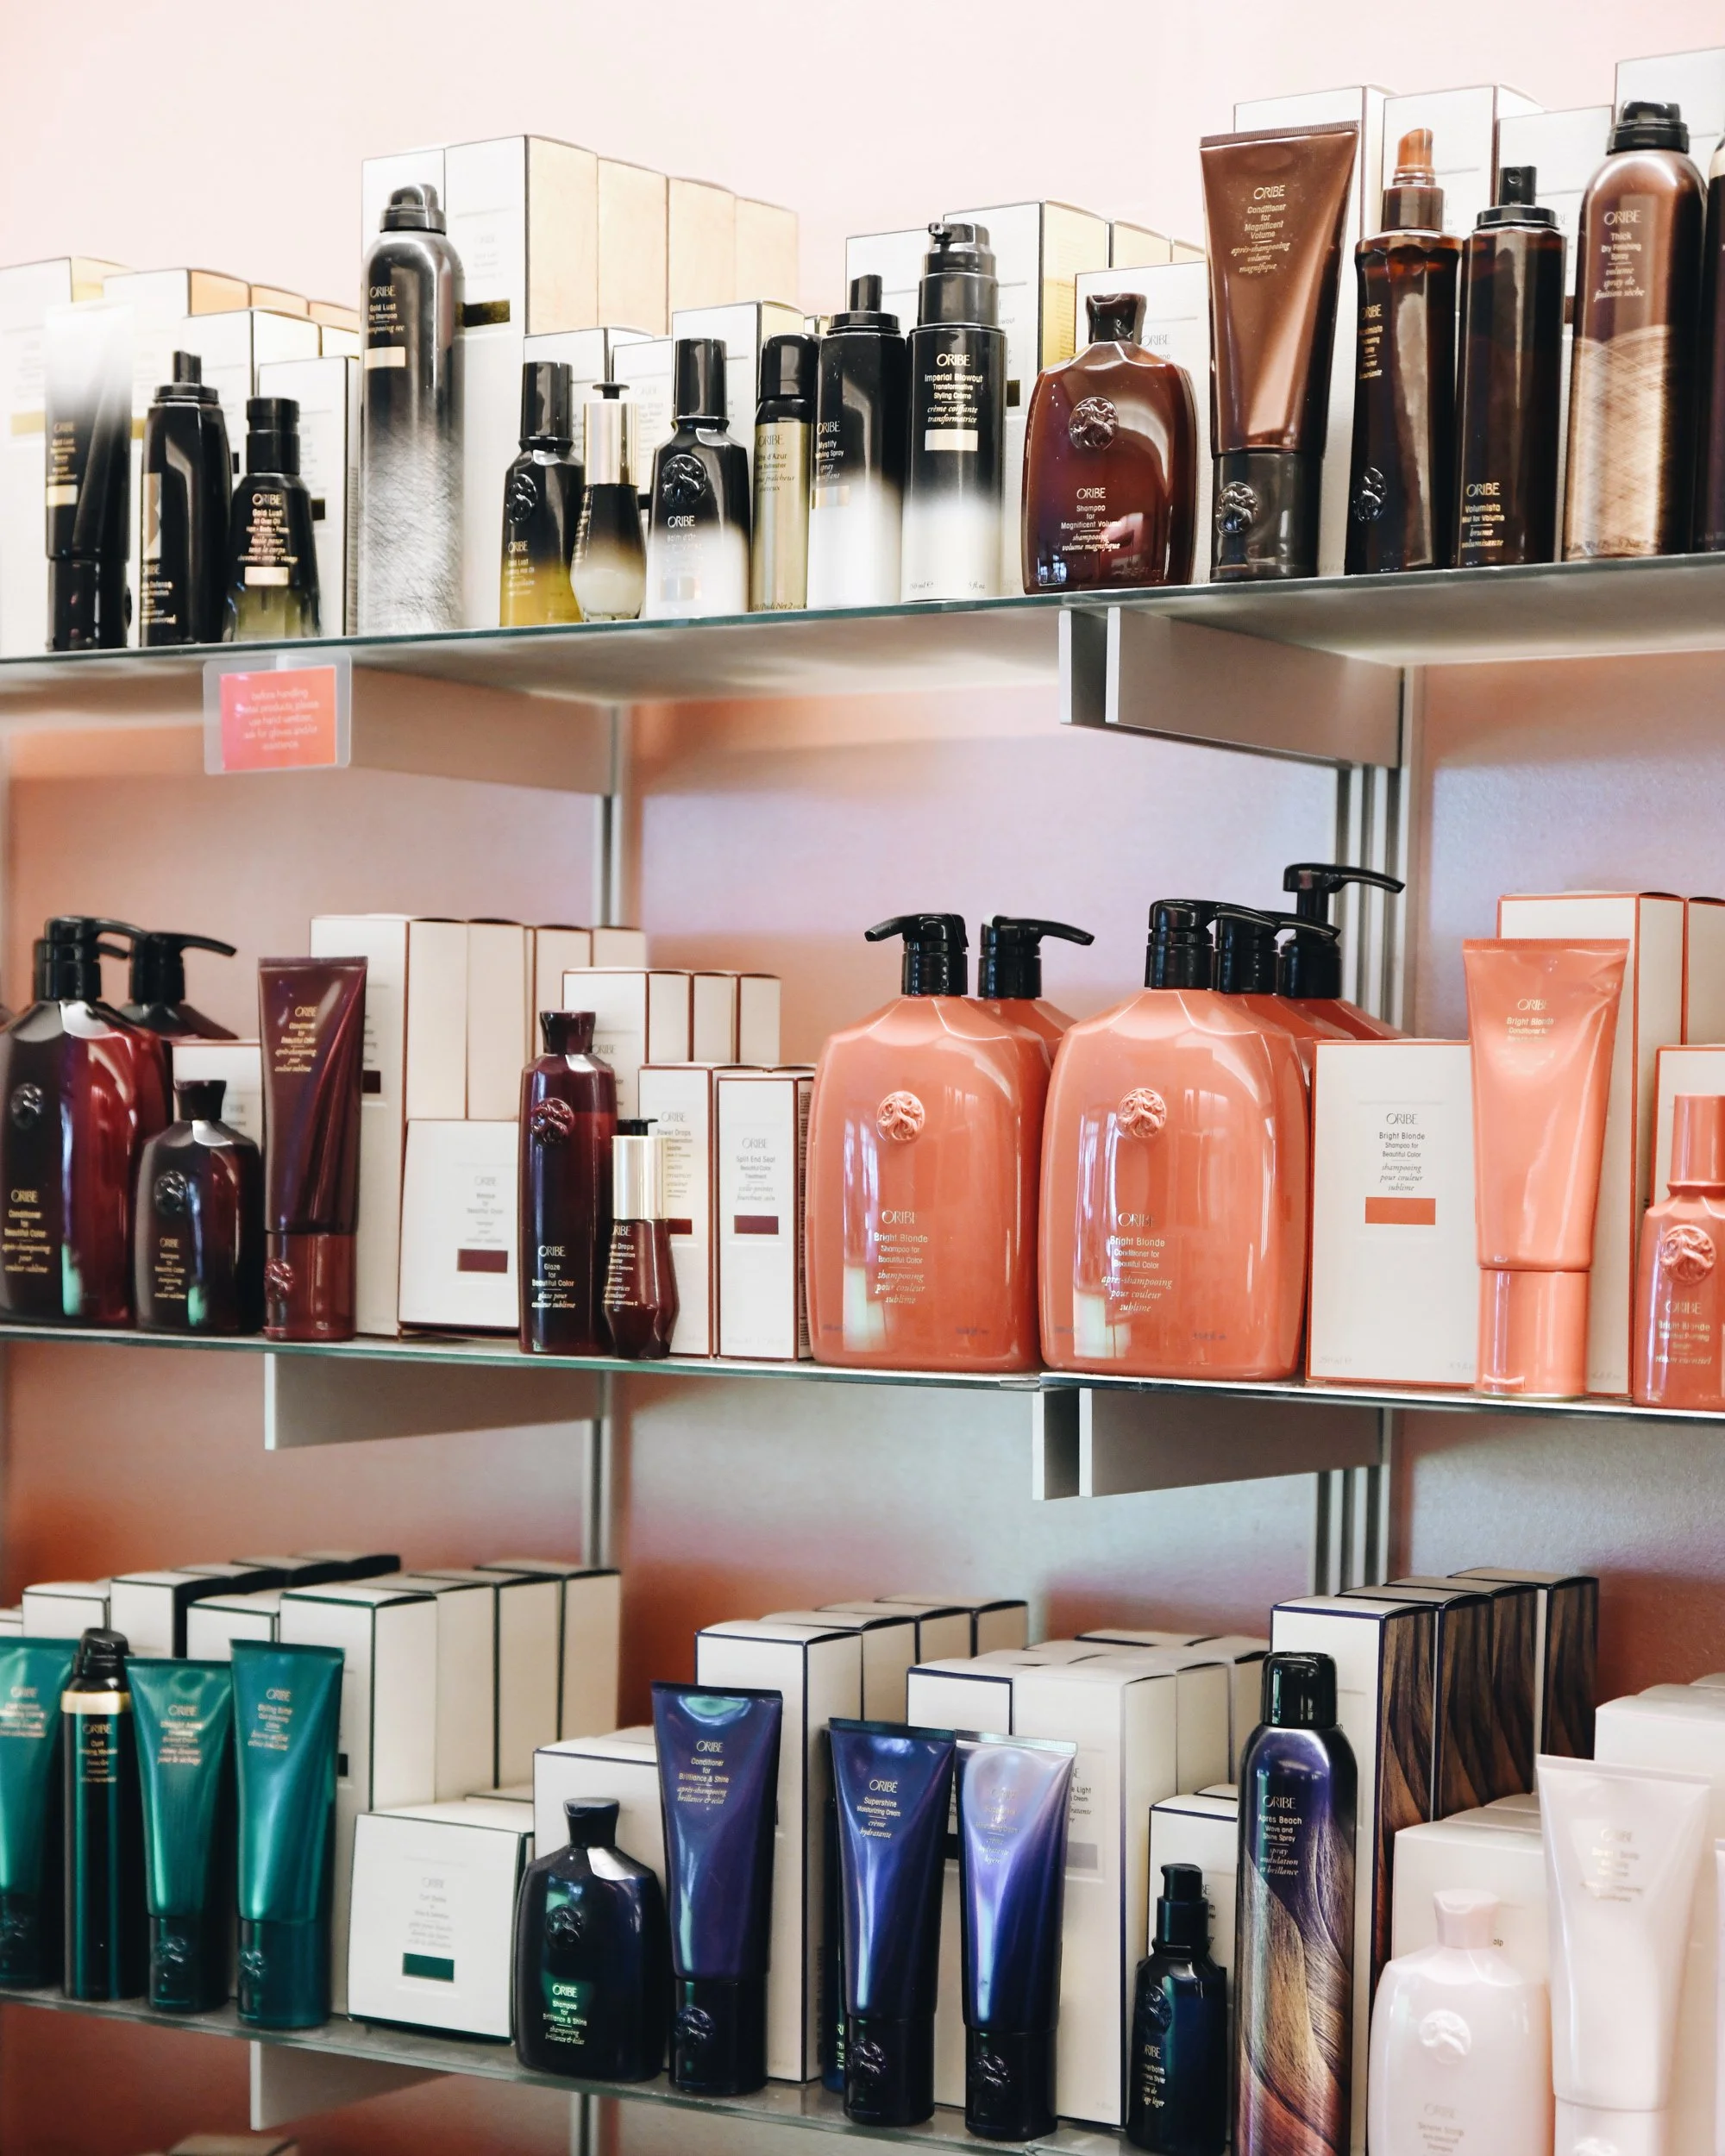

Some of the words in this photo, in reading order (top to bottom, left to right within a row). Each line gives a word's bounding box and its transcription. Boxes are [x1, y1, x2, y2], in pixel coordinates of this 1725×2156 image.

[1254, 185, 1285, 199] ORIBE
[1247, 204, 1286, 214] Conditioner
[1604, 210, 1642, 225] ORIBE
[1245, 221, 1283, 232] Magnificent
[1251, 231, 1275, 240] Volume
[1611, 232, 1632, 241] Thick
[370, 285, 396, 298] ORIBE
[382, 303, 396, 311] Lust
[1142, 334, 1170, 347] ORIBE
[937, 353, 971, 367] ORIBE
[924, 373, 952, 382] Imperial
[954, 373, 983, 382] Blowout
[927, 404, 947, 413] crème
[949, 404, 978, 414] coiffante
[928, 414, 977, 424] transformatrice
[817, 421, 841, 435] ORIBE
[758, 435, 785, 447] ORIBE
[1076, 487, 1106, 498] ORIBE
[1466, 482, 1501, 497] ORIBE
[252, 493, 283, 507] ORIBE
[252, 509, 267, 517] Gold
[268, 509, 284, 517] Lust
[1076, 505, 1106, 513] Shampoo
[1465, 504, 1501, 513] Volumista
[668, 515, 695, 528] ORIBE
[1061, 521, 1095, 530] Magnificent
[1073, 534, 1109, 543] shampooing
[508, 541, 529, 553] ORIBE
[1085, 542, 1120, 552] magnifique
[295, 1006, 317, 1017] ORIBE
[1506, 1017, 1529, 1027] Bright
[1531, 1018, 1554, 1026] Blonde
[662, 1112, 685, 1122] ORIBE
[1386, 1112, 1419, 1125] ORIBE
[1379, 1131, 1399, 1140] Bright
[1402, 1131, 1425, 1140] Blonde
[743, 1138, 768, 1149] ORIBE
[1382, 1163, 1422, 1174] shampooing
[1380, 1174, 1396, 1183] pour
[1397, 1173, 1423, 1181] couleur
[1388, 1182, 1414, 1192] sublime
[11, 1189, 38, 1203] ORIBE
[160, 1238, 179, 1248] ORIBE
[874, 1232, 897, 1243] Bright
[900, 1233, 928, 1243] Blonde
[1110, 1236, 1133, 1246] Bright
[1136, 1238, 1165, 1247] Blonde
[538, 1245, 566, 1257] ORIBE
[881, 1244, 910, 1253] Shampoo
[878, 1269, 924, 1282] shampooing
[531, 1279, 556, 1288] Beautiful
[875, 1284, 894, 1294] pour
[897, 1283, 925, 1293] couleur
[885, 1294, 916, 1304] sublime
[1109, 1289, 1129, 1300] pour
[1132, 1289, 1162, 1300] couleur
[1120, 1301, 1151, 1312] sublime
[267, 1689, 291, 1702] ORIBE
[168, 1705, 198, 1717] ORIBE
[697, 1740, 723, 1753] ORIBE
[691, 1758, 724, 1767] Conditioner
[679, 1773, 707, 1783] Brilliance
[869, 1779, 898, 1794] ORIBE
[1076, 1786, 1092, 1796] Light
[677, 1792, 704, 1803] brillance
[864, 1796, 897, 1808] Supershine
[1263, 1795, 1296, 1809] ORIBE
[856, 1806, 885, 1816] Moisturizing
[1279, 1816, 1302, 1825] Beach
[860, 1827, 893, 1839] hydratante
[1279, 1834, 1295, 1843] Spray
[1260, 1856, 1298, 1865] ondulation
[1268, 1865, 1299, 1876] brillance
[553, 1984, 578, 1998] ORIBE
[553, 2001, 577, 2010] Shampoo
[543, 2013, 566, 2023] Brilliance
[573, 2018, 587, 2027] Shine
